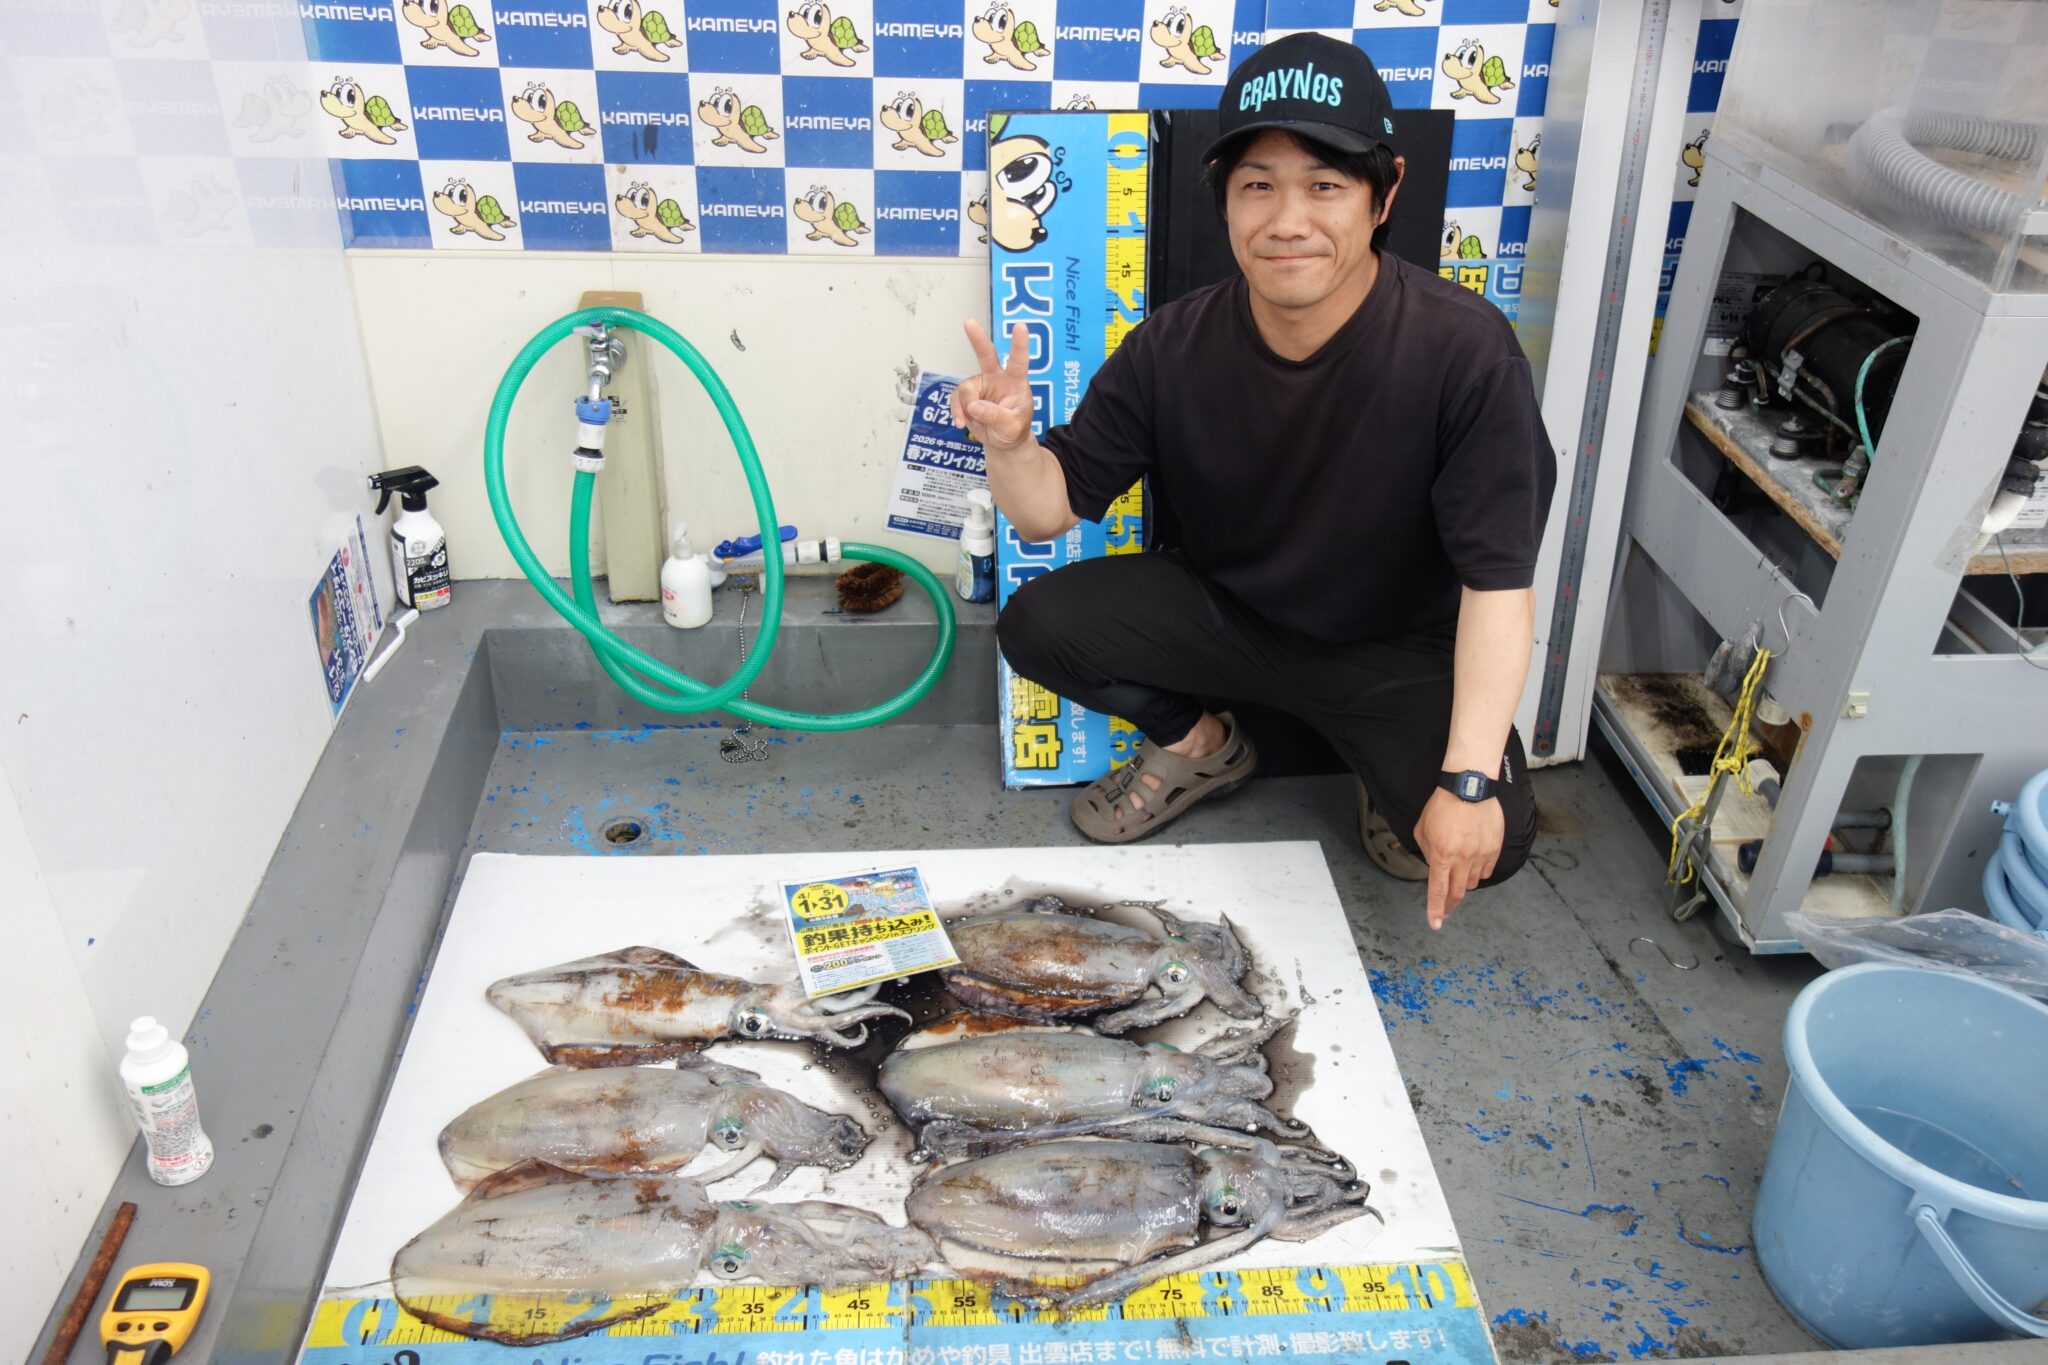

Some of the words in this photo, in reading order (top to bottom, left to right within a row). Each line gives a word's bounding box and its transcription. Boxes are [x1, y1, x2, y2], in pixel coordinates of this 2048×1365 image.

[301, 5, 393, 22] KAMEYA
[495, 11, 587, 28] KAMEYA
[687, 17, 777, 33] KAMEYA
[875, 22, 964, 39] KAMEYA
[1055, 26, 1141, 42] KAMEYA
[1378, 67, 1433, 81] MEYA
[1694, 59, 1729, 74] KAM
[1239, 62, 1344, 113] CRAYNOS
[413, 105, 504, 122] KAMEYA
[602, 111, 690, 127] KAMEYA
[785, 115, 871, 131] KAMEYA
[1450, 156, 1506, 171] MEYA
[1122, 187, 1132, 197] 5
[337, 196, 425, 212] KAMEYA
[520, 200, 607, 215] KAMEYA
[700, 203, 785, 218] KAMEYA
[876, 207, 959, 222] KAMEYA
[1121, 261, 1131, 278] 15
[1065, 256, 1081, 300] Nice
[1065, 305, 1081, 351] Fish!
[910, 434, 937, 445] 2026
[341, 1298, 399, 1345] 0
[524, 1308, 546, 1320] 15
[668, 1287, 720, 1335] 3
[741, 1303, 765, 1314] 35
[774, 1284, 828, 1331] 4
[847, 1299, 870, 1311] 45
[953, 1296, 976, 1309] 55
[1160, 1289, 1183, 1301] 75
[1200, 1271, 1249, 1317] 8
[1261, 1285, 1284, 1297] 85
[1295, 1266, 1347, 1313] 9
[1362, 1281, 1385, 1293] 95
[1387, 1263, 1457, 1310] 10
